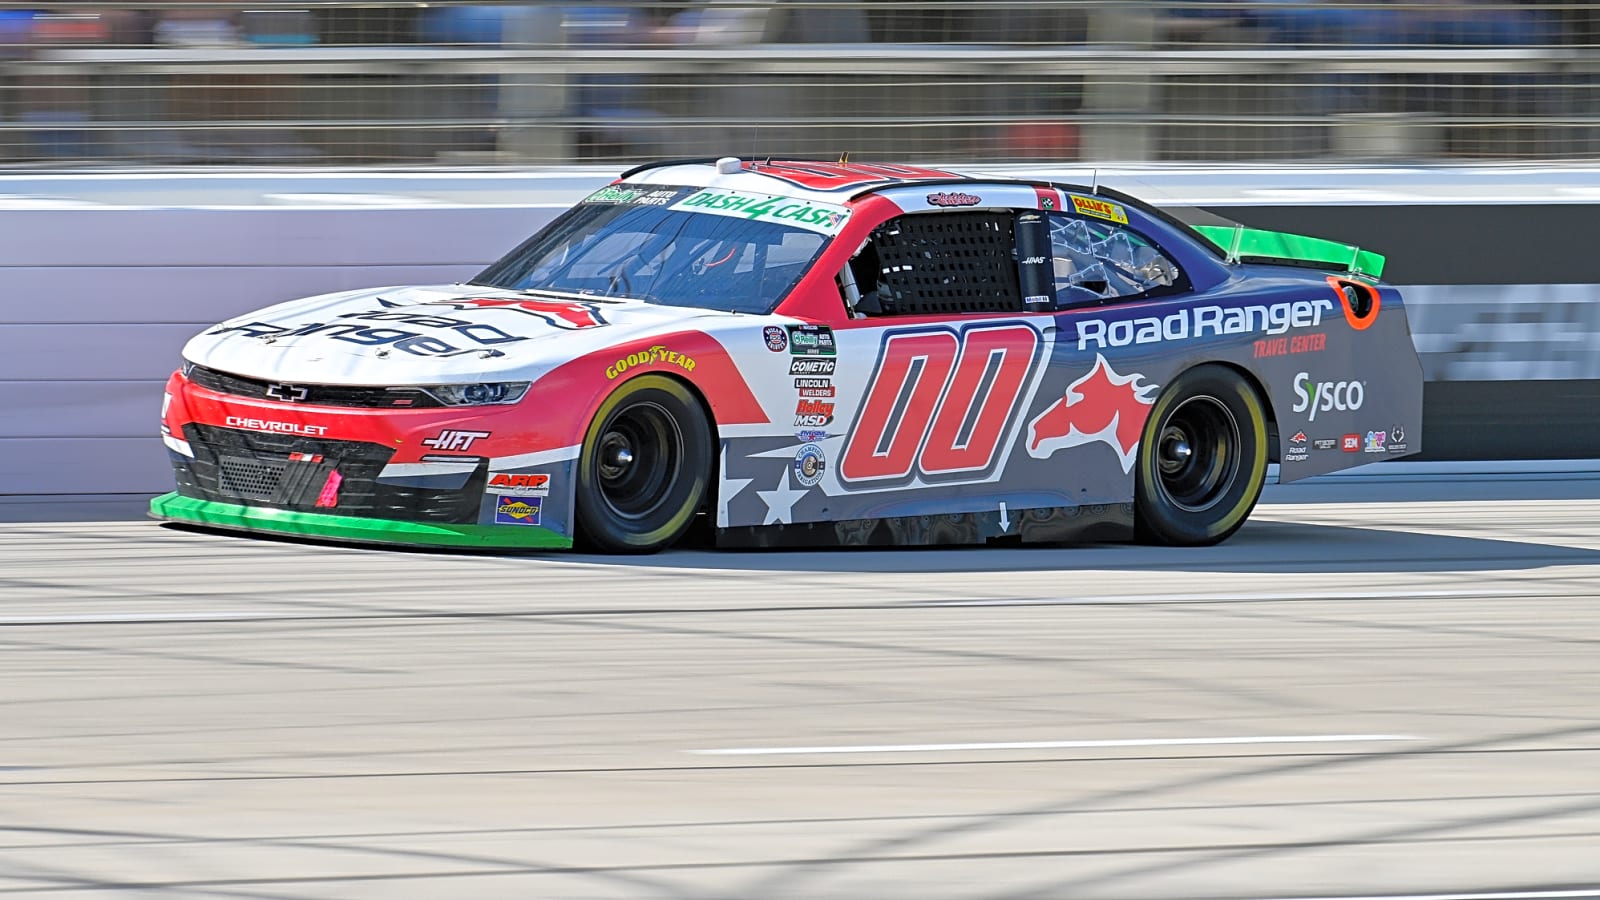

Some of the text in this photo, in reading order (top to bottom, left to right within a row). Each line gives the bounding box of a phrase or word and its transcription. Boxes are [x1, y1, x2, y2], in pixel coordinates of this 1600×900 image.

[633, 197, 671, 205] PARTS
[682, 193, 756, 211] DASH
[741, 197, 786, 220] 4
[1077, 299, 1333, 351] Road Ranger
[1254, 334, 1327, 358] TRAVEL CENTER
[605, 347, 696, 379] GOODYEAR
[791, 361, 835, 372] COMETIC
[796, 379, 829, 388] LINCOLN
[797, 399, 835, 417] Holley
[838, 324, 1041, 487] 00
[226, 416, 328, 436] CHEVROLET
[794, 415, 830, 427] MSD
[1286, 453, 1309, 462] Ranger
[488, 474, 548, 487] ARP
[500, 505, 537, 515] SUNOCO
